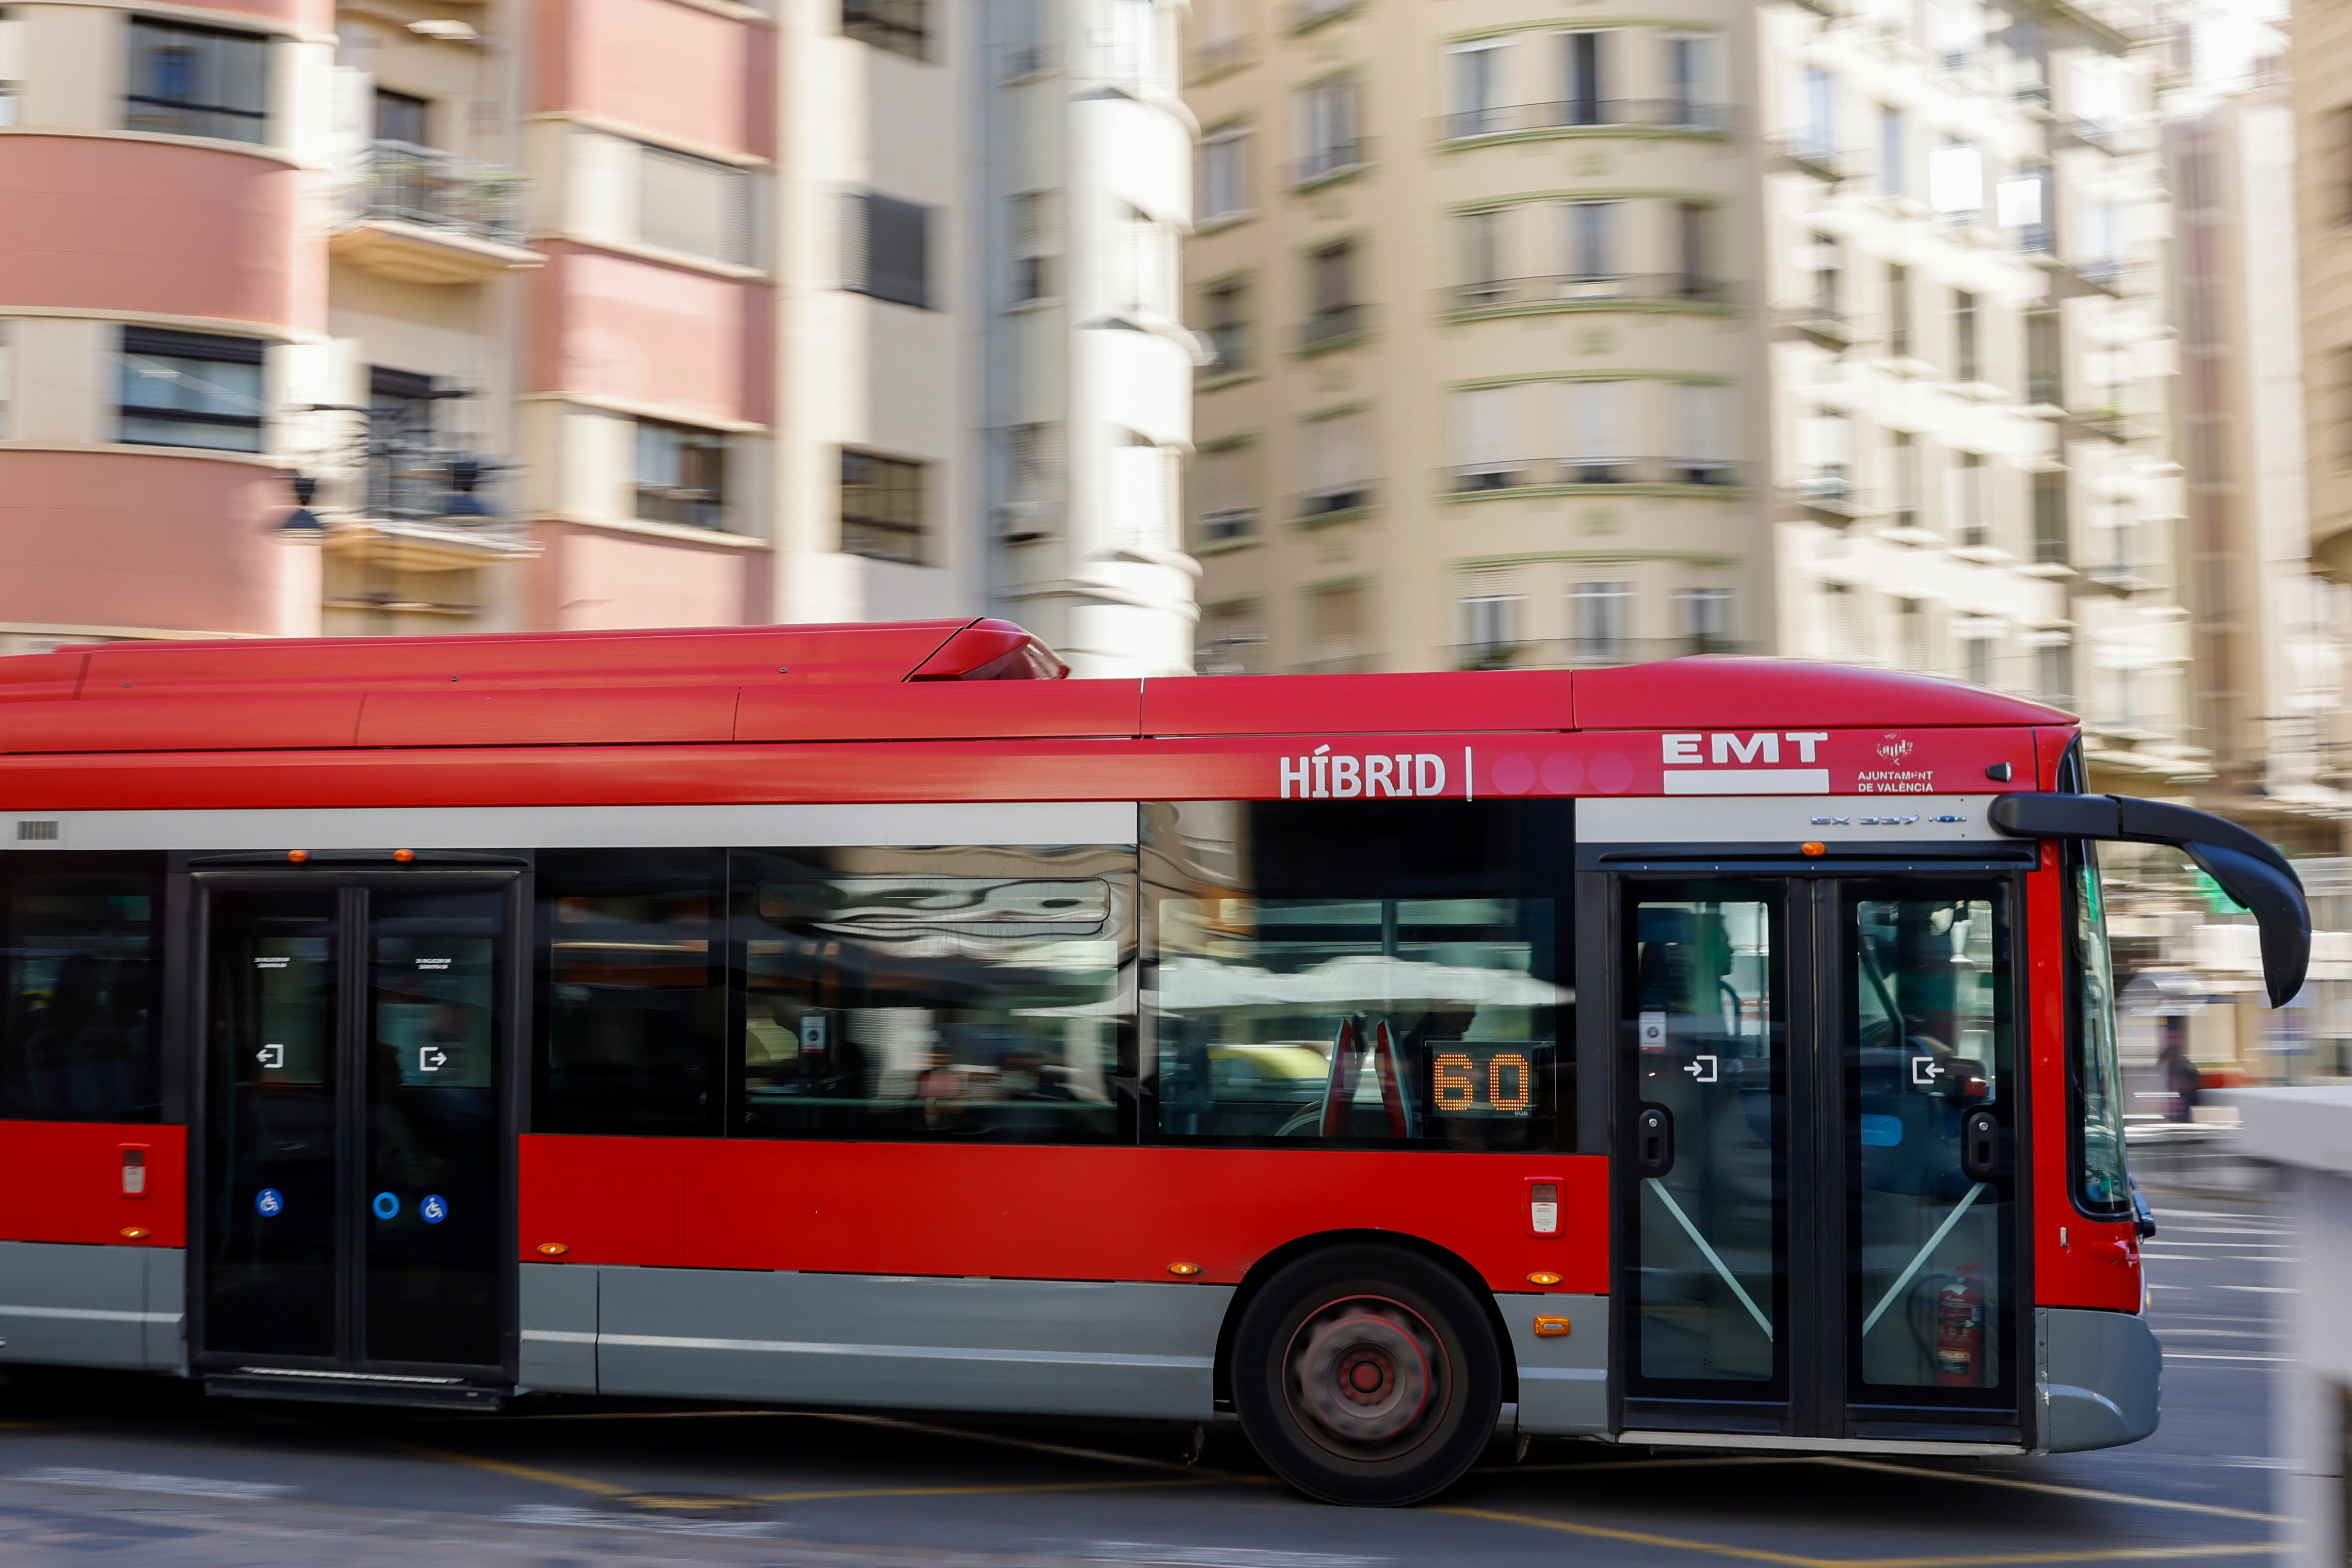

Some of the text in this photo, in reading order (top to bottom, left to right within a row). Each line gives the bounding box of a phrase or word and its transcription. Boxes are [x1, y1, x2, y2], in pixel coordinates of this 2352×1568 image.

[1662, 732, 1828, 764] EMT
[1280, 744, 1445, 798] HÍBRID
[1859, 781, 1933, 792] DE VALÈNCIA
[1434, 1054, 1528, 1110] 60
